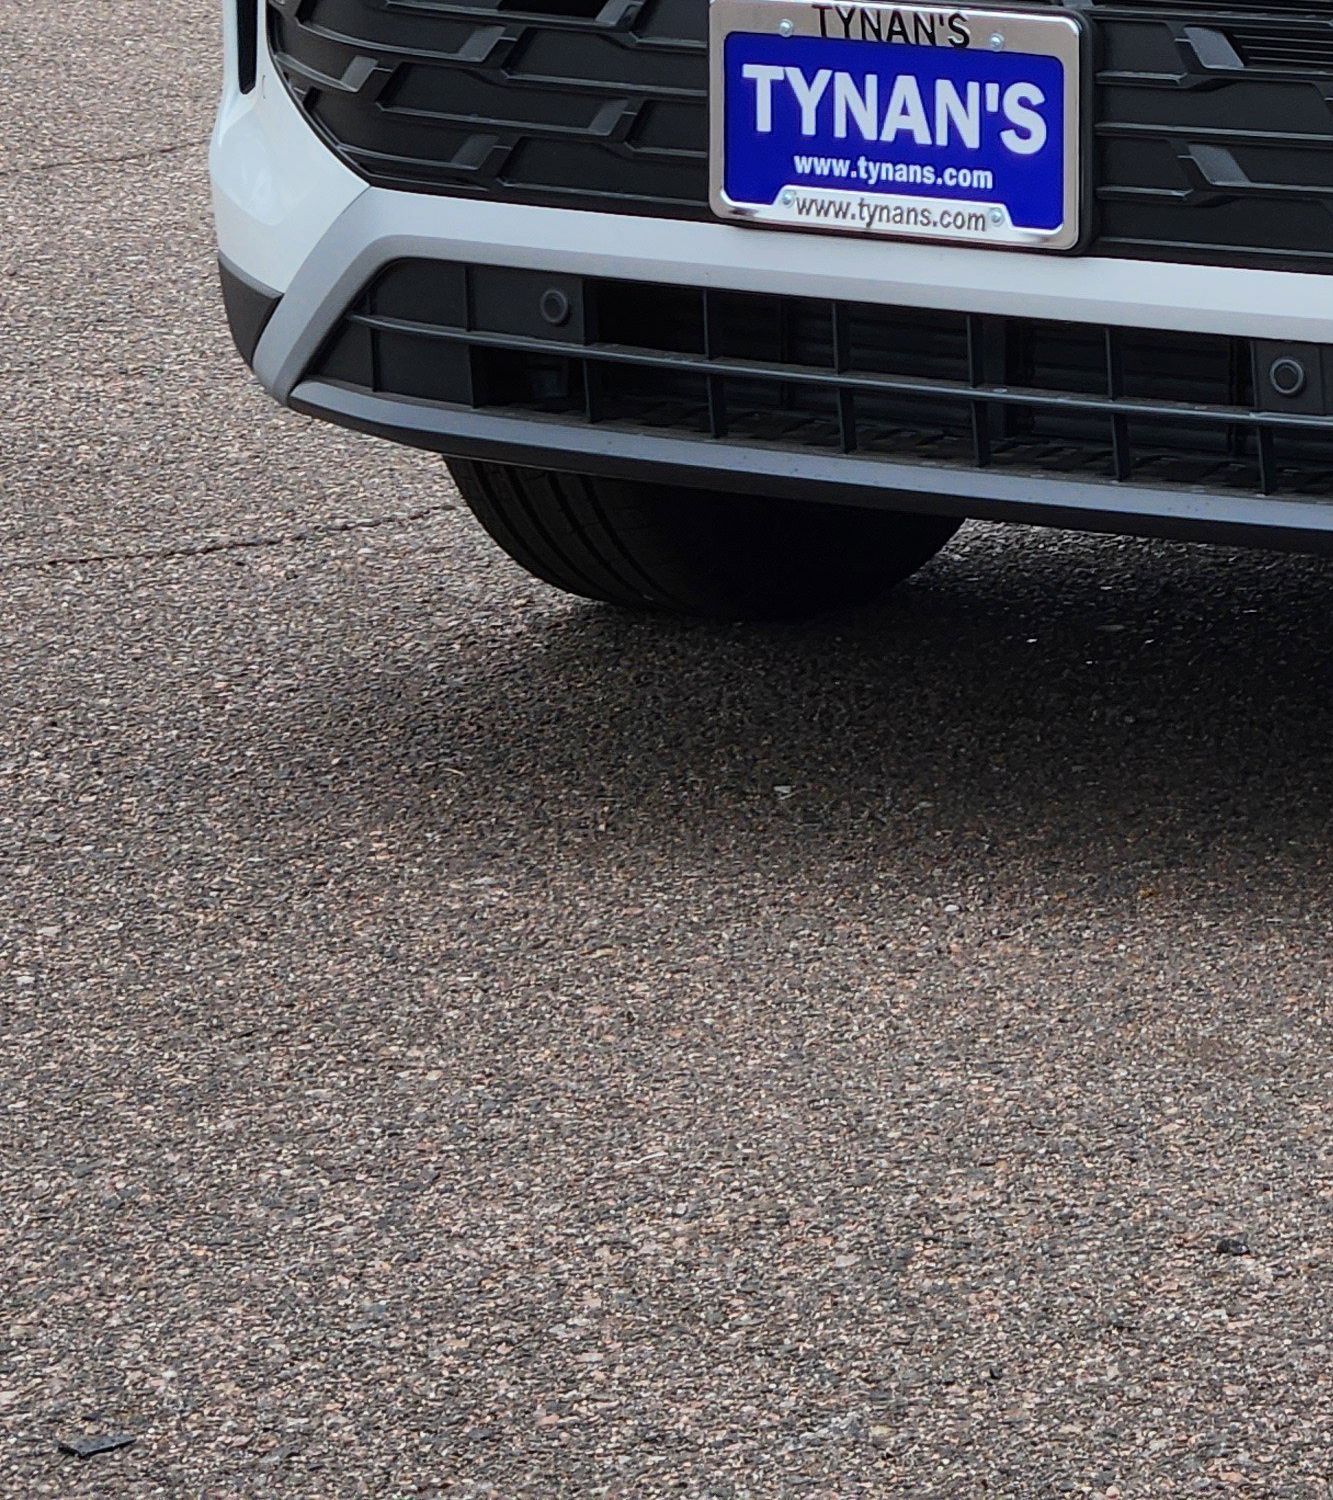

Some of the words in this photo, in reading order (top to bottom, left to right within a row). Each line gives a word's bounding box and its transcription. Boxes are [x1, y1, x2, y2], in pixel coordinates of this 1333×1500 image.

[812, 4, 970, 49] TYNAN'S
[742, 63, 1047, 156] TYNAN'S
[793, 154, 993, 190] www.tynans.com
[795, 196, 986, 232] www.tynans.com
